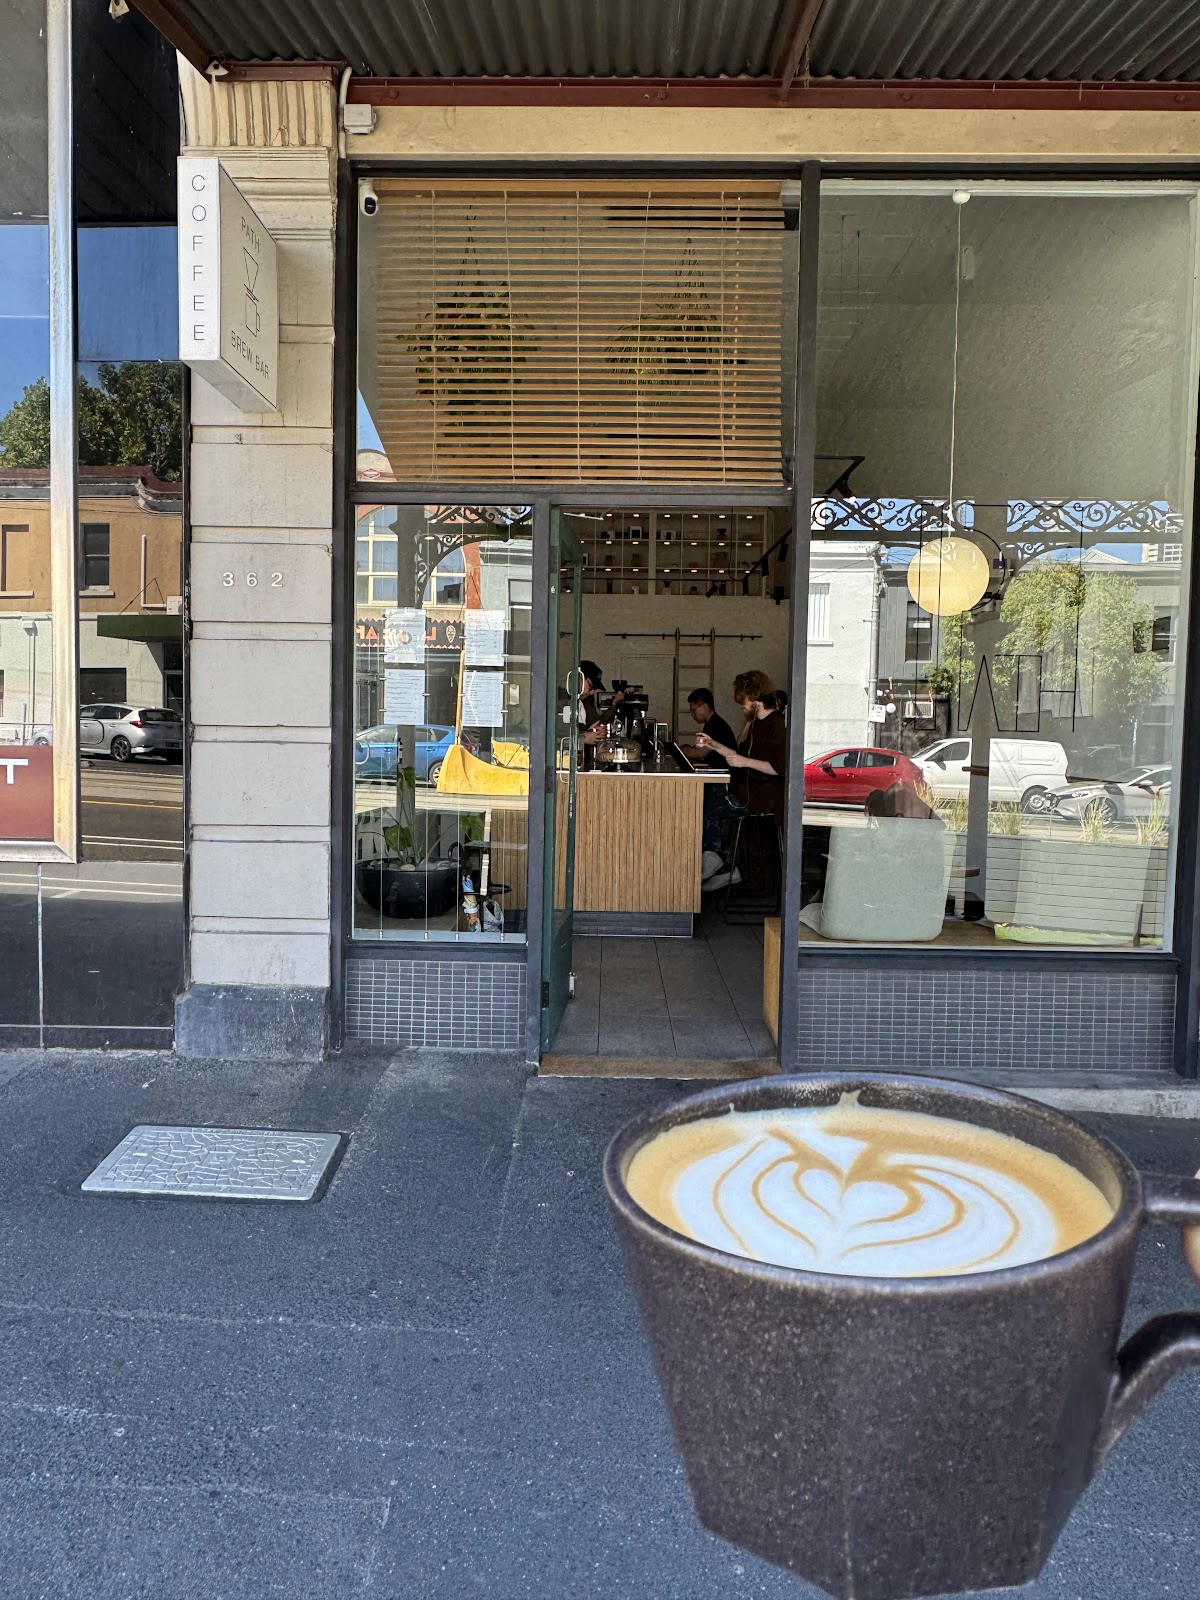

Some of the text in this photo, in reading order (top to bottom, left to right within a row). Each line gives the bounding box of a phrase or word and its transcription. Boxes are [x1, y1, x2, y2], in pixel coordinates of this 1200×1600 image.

[241, 216, 260, 253] PATH
[191, 174, 207, 341] COFFEE
[231, 330, 270, 381] BREW BAR
[222, 571, 284, 587] 362
